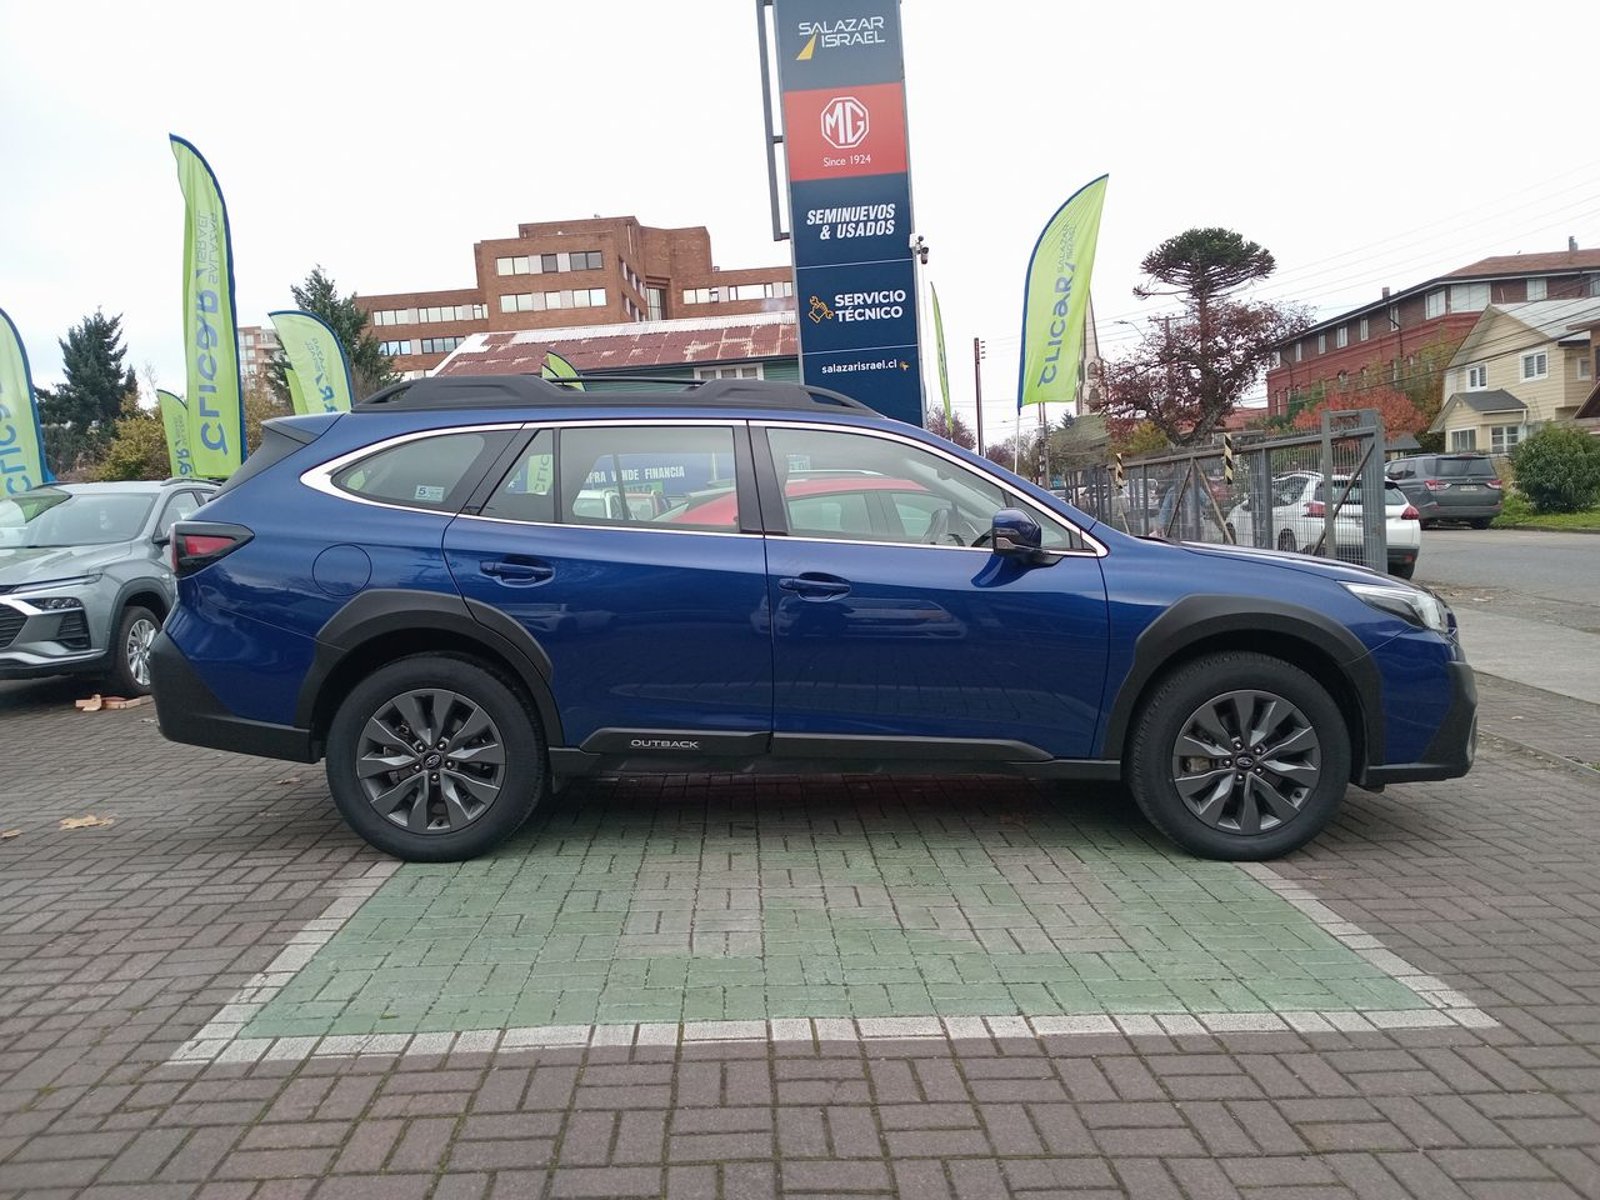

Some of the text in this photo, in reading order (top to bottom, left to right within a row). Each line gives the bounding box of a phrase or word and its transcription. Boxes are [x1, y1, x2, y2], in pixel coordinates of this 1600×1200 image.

[798, 16, 884, 36] SALAZAR
[821, 31, 885, 48] ISRAEL
[825, 101, 865, 144] MG
[823, 154, 871, 167] Since 1924
[806, 203, 896, 225] SEMINUEVOS
[819, 219, 896, 241] & USADOS
[834, 289, 906, 307] SERVICIO
[835, 305, 903, 322] TÉCNICO
[821, 358, 897, 374] salazarisrael.cl
[611, 469, 640, 482] VNDE
[644, 466, 685, 479] FINANCIA
[630, 739, 699, 749] OUTBACK
